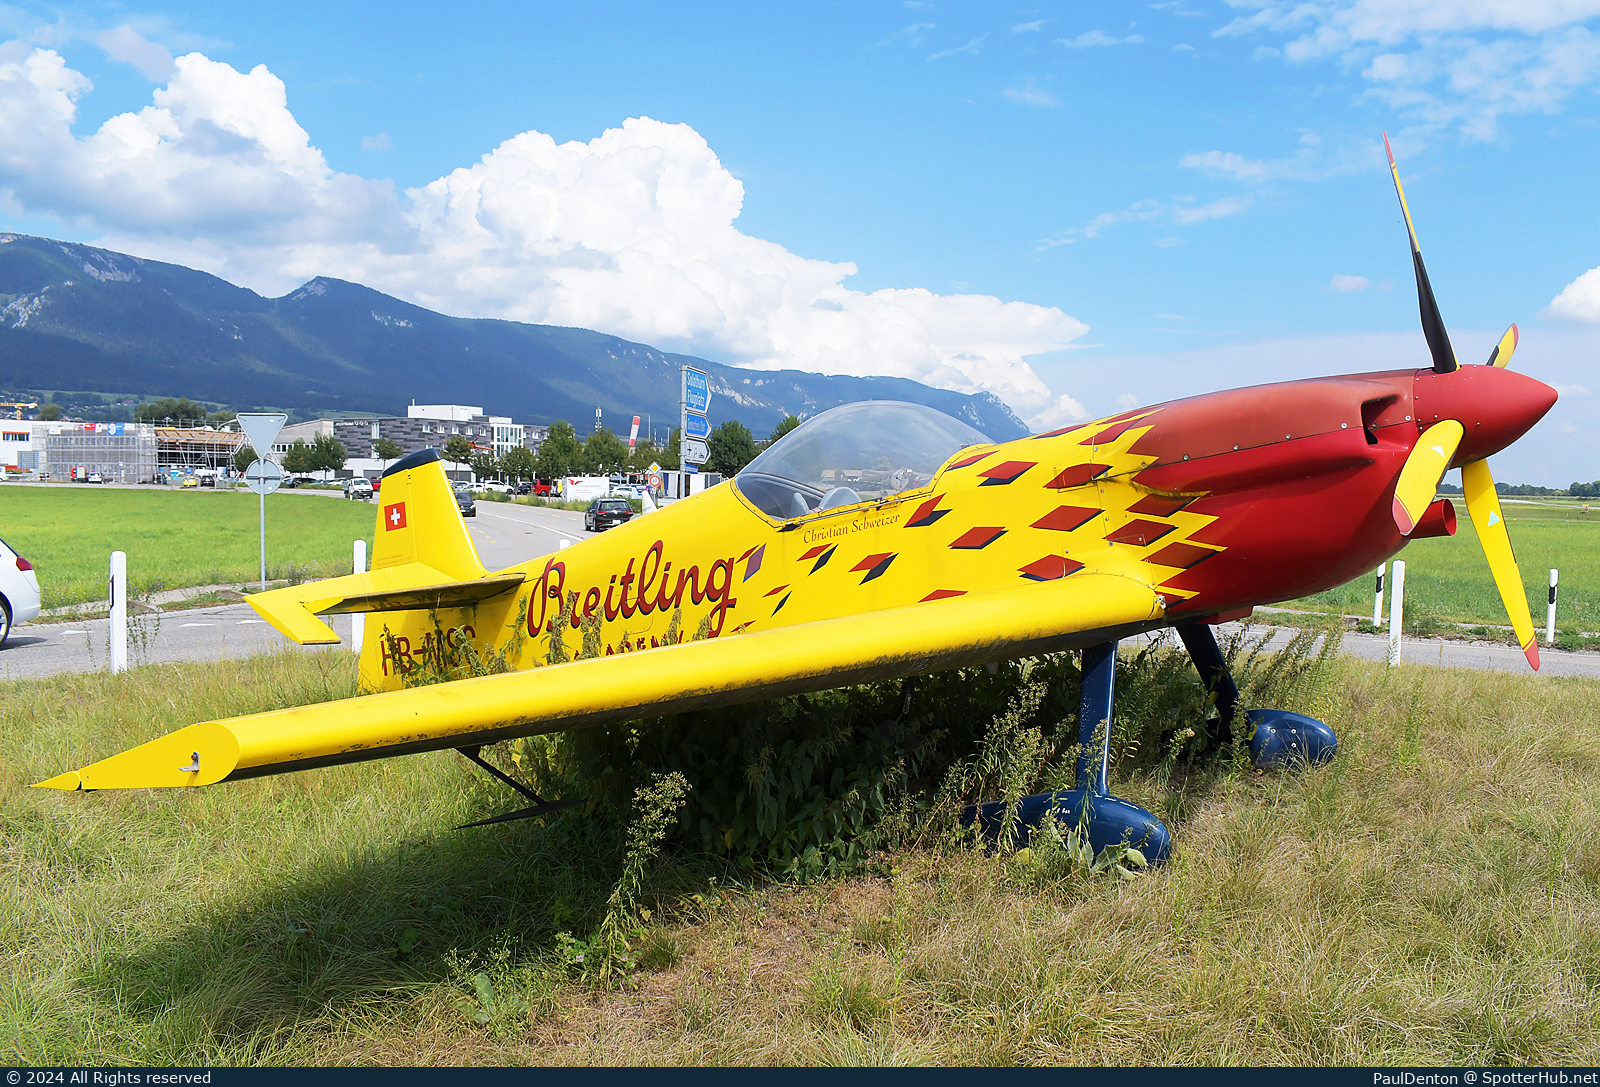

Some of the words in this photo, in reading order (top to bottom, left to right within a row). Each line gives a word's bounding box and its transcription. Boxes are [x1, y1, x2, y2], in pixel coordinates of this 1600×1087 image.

[803, 524, 848, 544] Christian
[851, 513, 900, 533] Schweizer
[527, 539, 738, 639] Breitling
